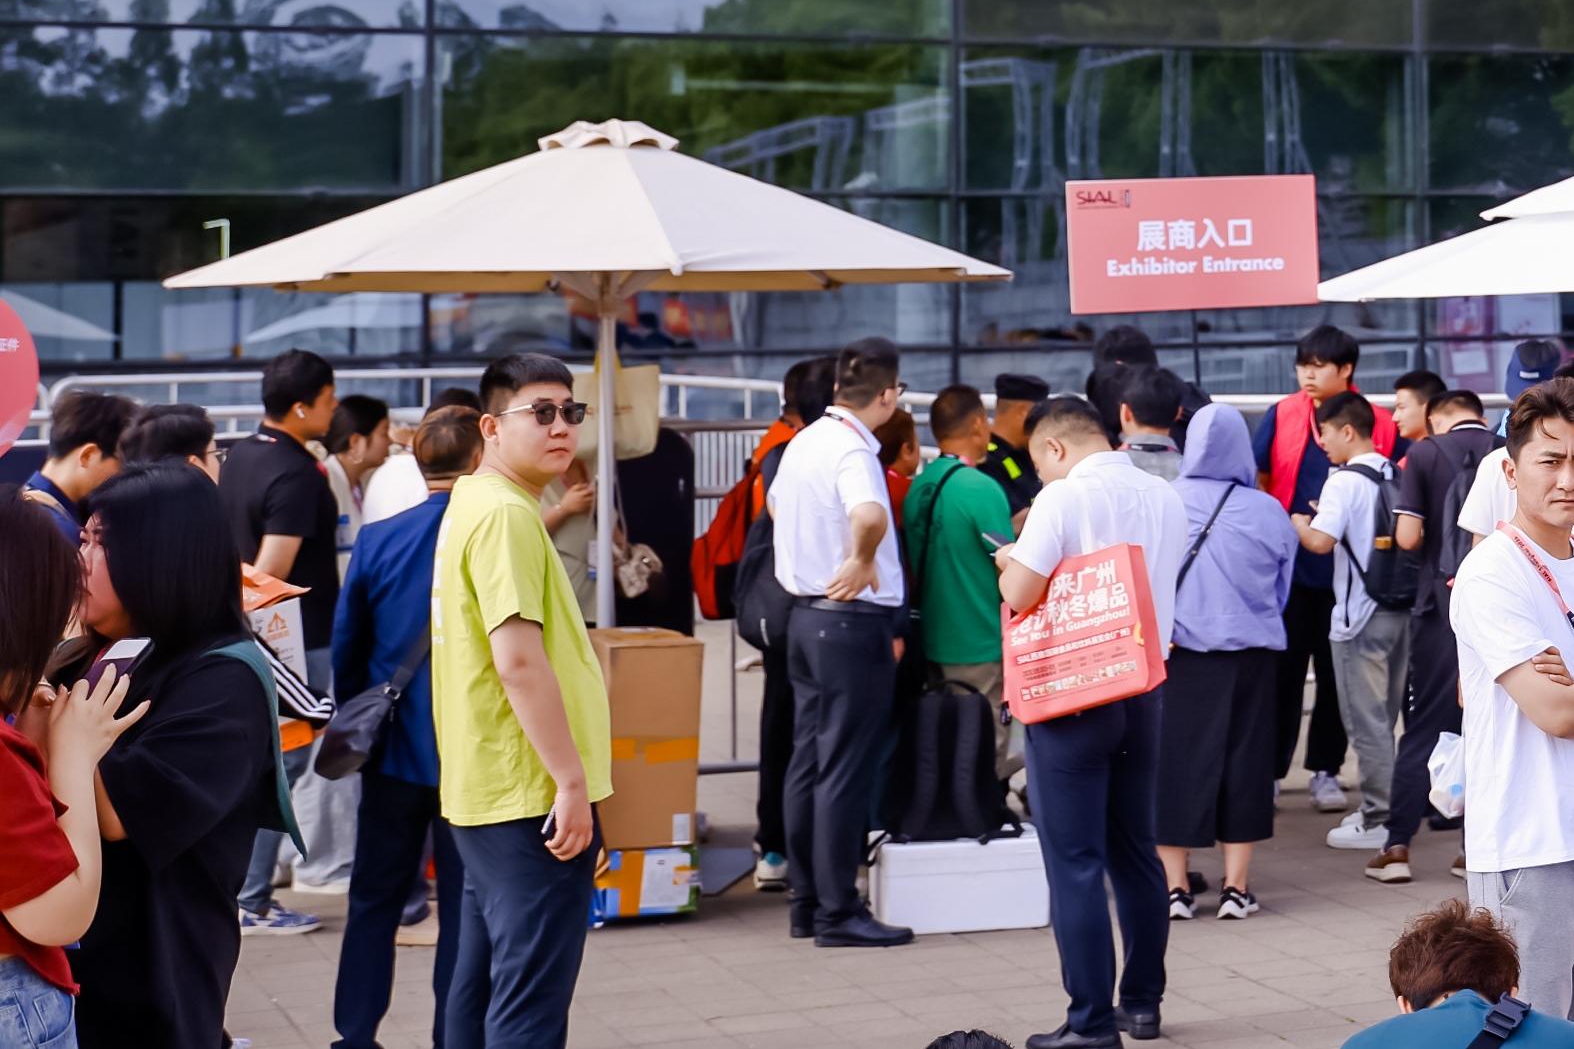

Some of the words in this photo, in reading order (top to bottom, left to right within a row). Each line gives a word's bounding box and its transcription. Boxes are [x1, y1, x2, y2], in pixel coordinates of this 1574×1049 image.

[1137, 218, 1253, 251] 展商入口
[1106, 258, 1197, 277] Exhibitor
[1202, 255, 1285, 274] Entrance
[1010, 634, 1028, 647] See
[1030, 630, 1049, 642] You
[1052, 625, 1064, 637] in
[1065, 606, 1131, 632] Guangzhou!
